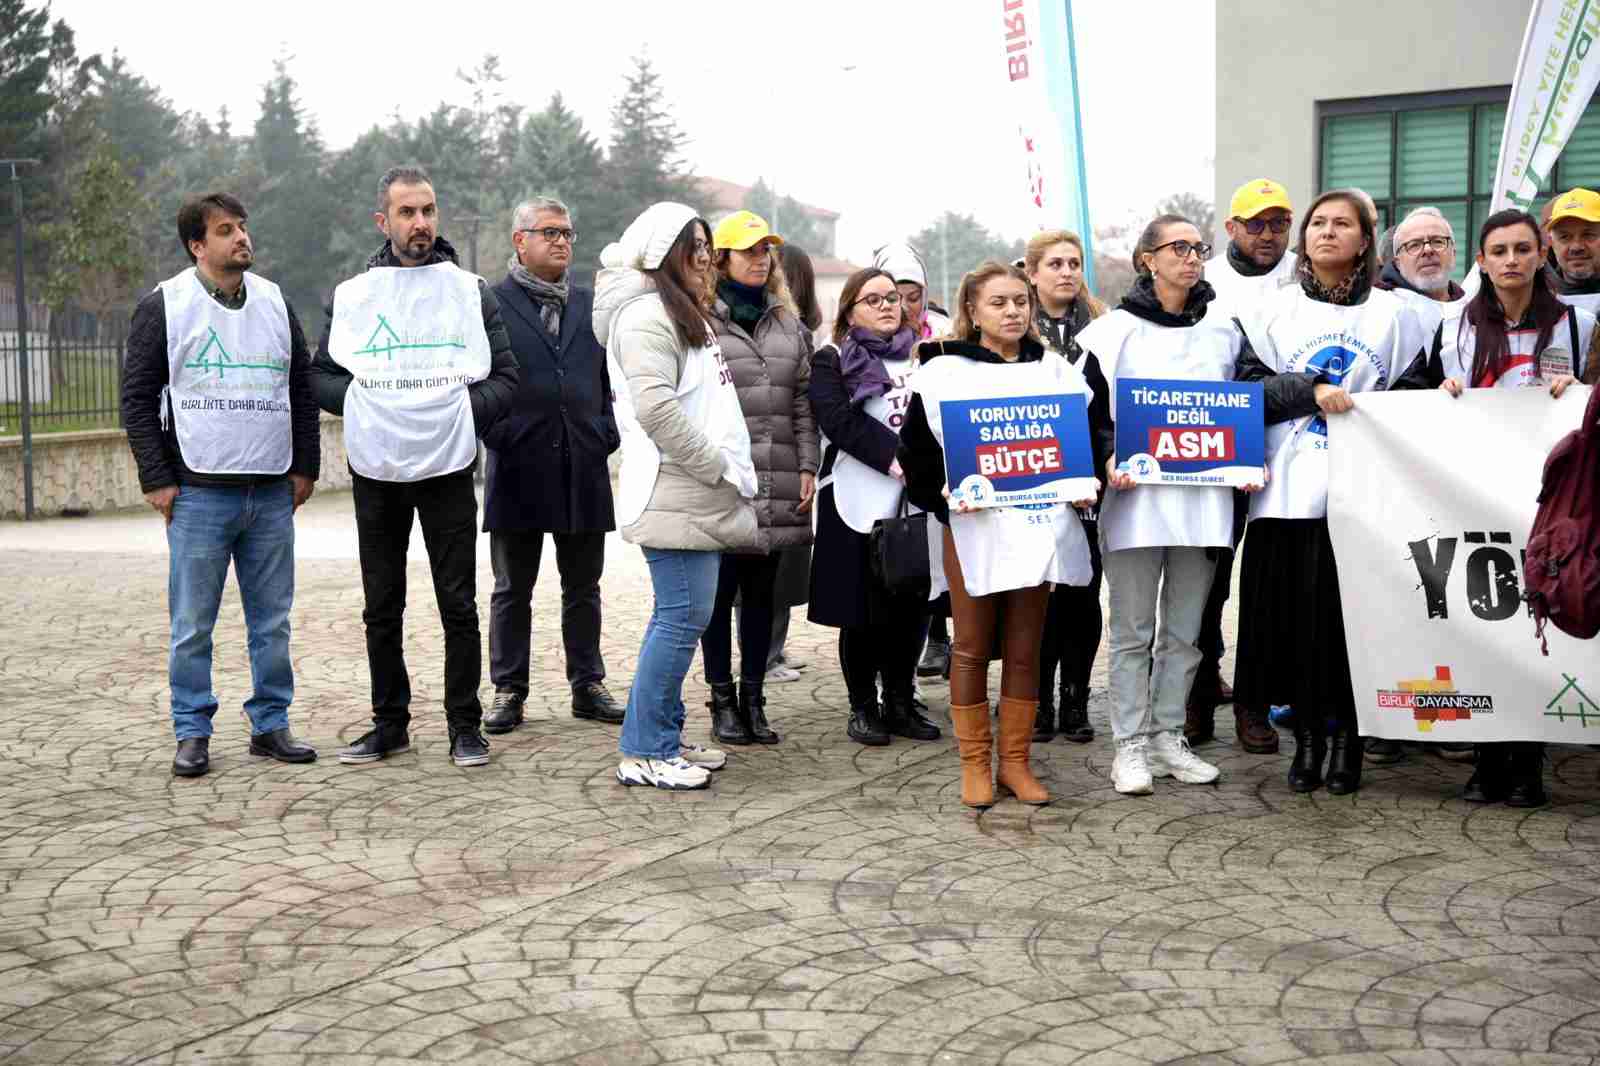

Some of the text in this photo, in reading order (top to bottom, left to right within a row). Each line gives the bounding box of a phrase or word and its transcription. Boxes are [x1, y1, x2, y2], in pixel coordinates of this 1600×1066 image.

[1131, 386, 1251, 408] TİCARETHANE
[969, 403, 1061, 424] KORUYUCU
[1166, 407, 1216, 425] DEĞİL
[979, 421, 1055, 442] SAĞLIĞA
[1154, 431, 1226, 459] ASM
[978, 446, 1060, 476] BÜTÇE
[1404, 531, 1536, 621] YÖ
